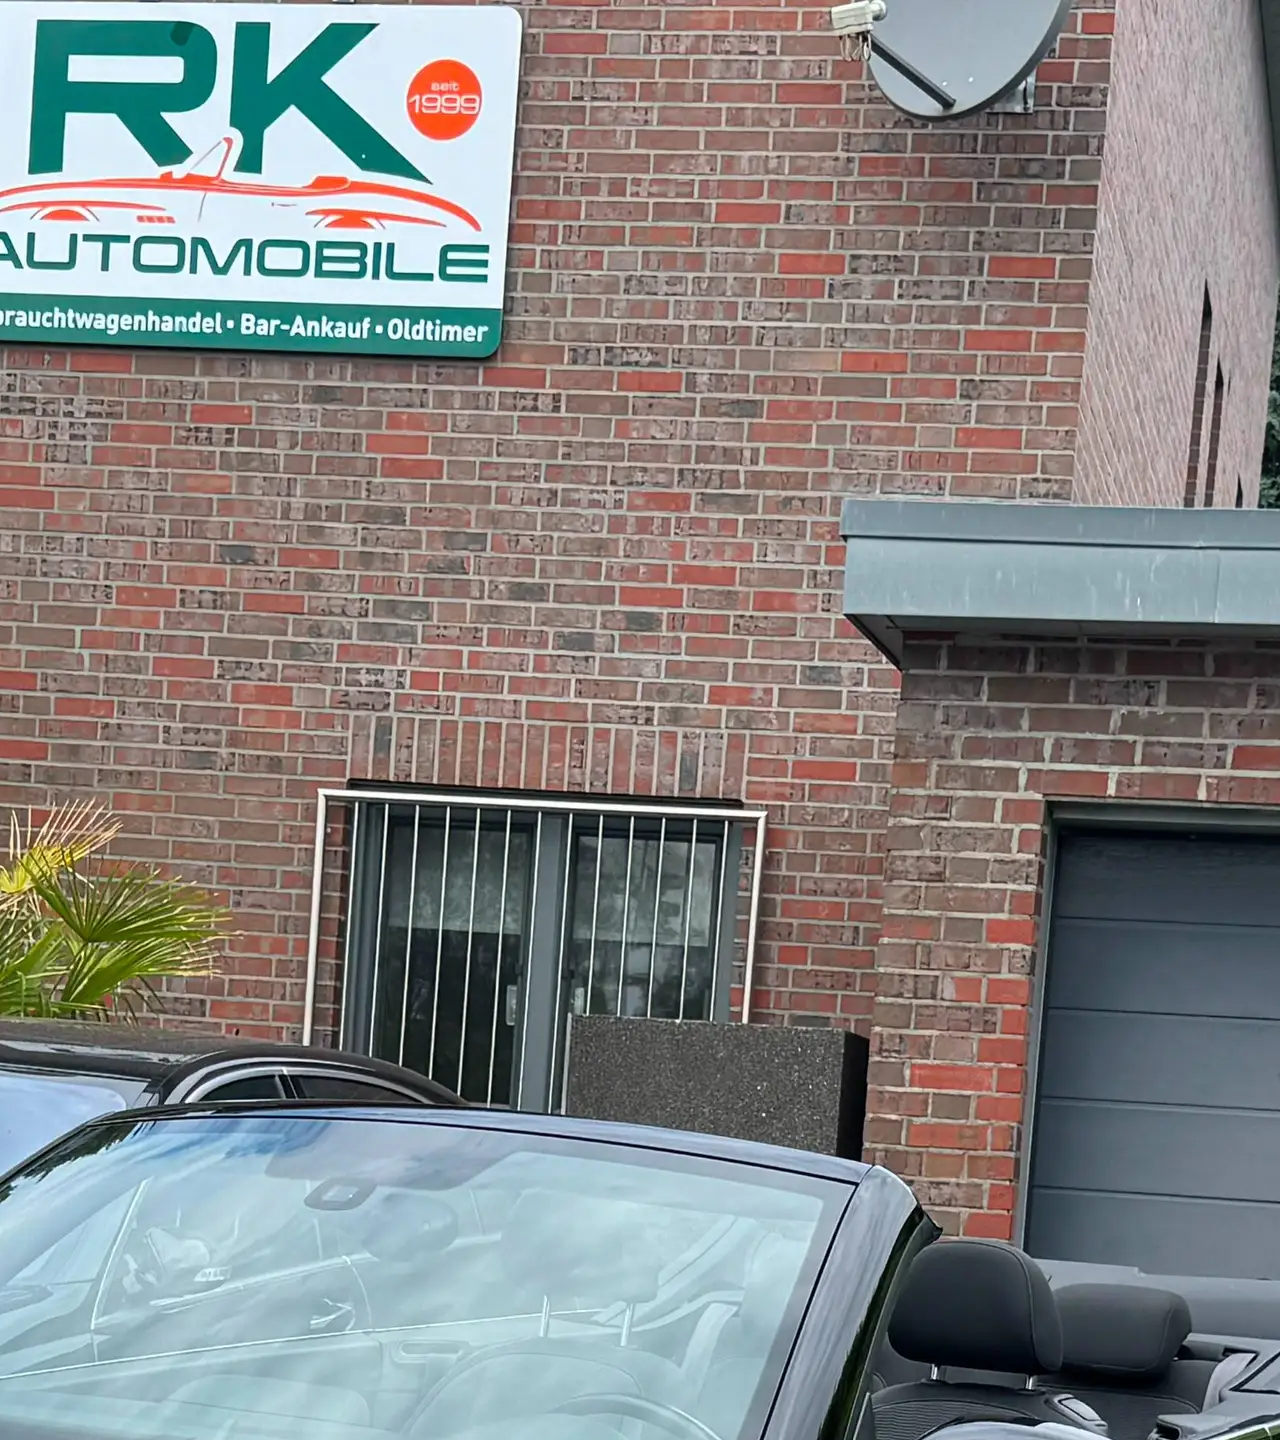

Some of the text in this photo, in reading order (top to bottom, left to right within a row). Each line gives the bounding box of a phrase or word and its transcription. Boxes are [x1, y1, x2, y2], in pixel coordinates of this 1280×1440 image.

[431, 80, 460, 92] seit
[28, 19, 433, 185] RK
[408, 94, 480, 115] 1999
[240, 312, 371, 341] Bar-Ankauf
[387, 317, 488, 343] Oldtimer
